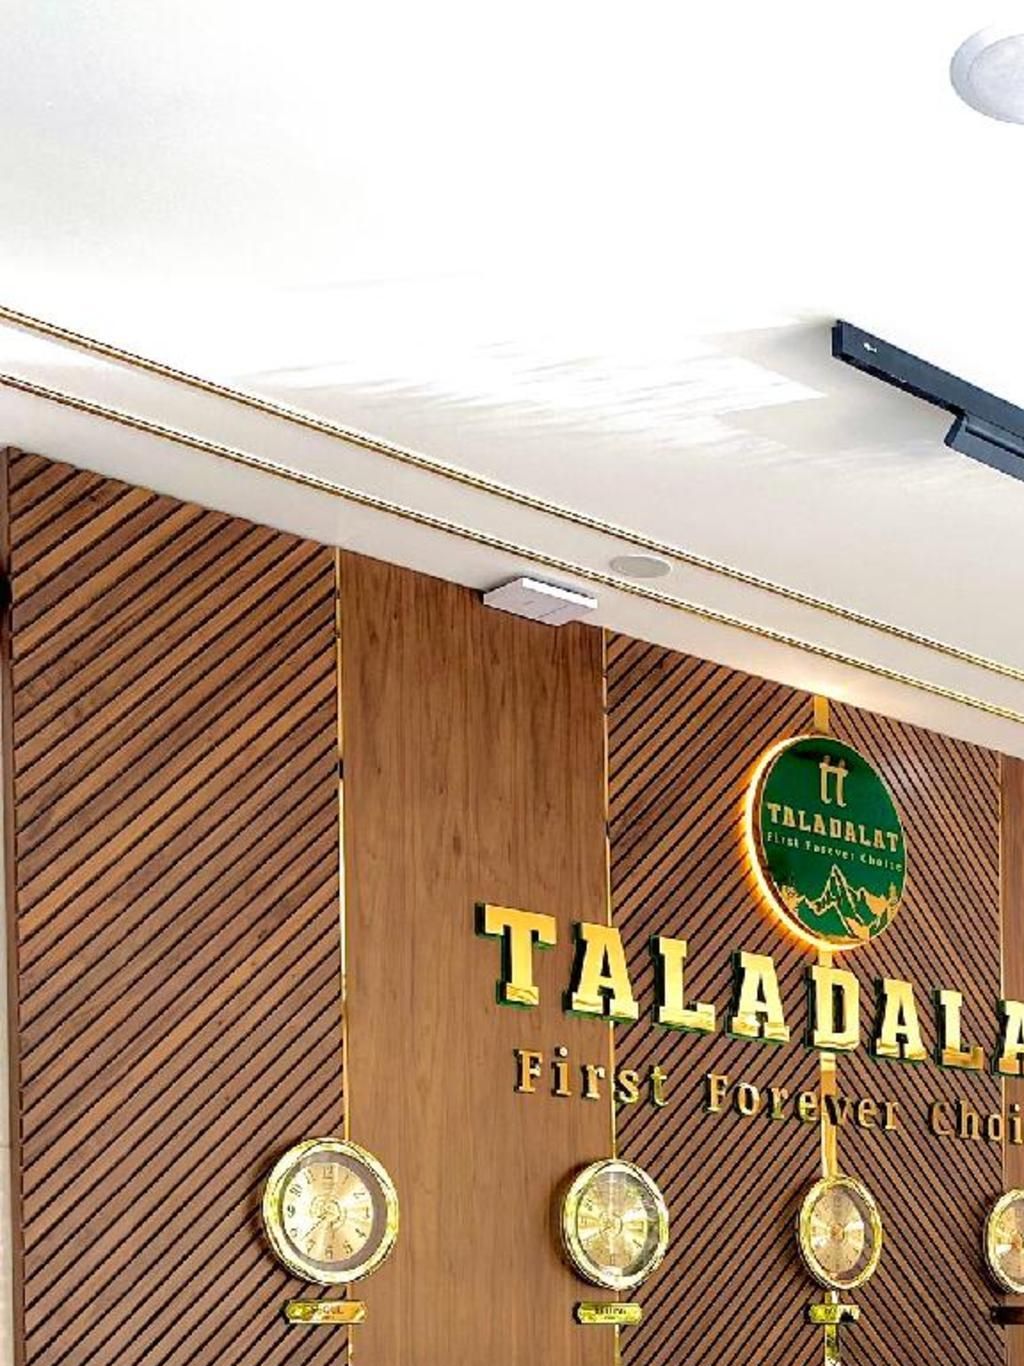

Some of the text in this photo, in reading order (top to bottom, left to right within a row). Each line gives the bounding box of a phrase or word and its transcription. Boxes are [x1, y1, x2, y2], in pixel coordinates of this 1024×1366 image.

[766, 802, 899, 853] TALADALAT
[767, 831, 903, 873] First Forever Choice
[515, 1046, 668, 1107] First
[703, 1071, 900, 1132] Forever
